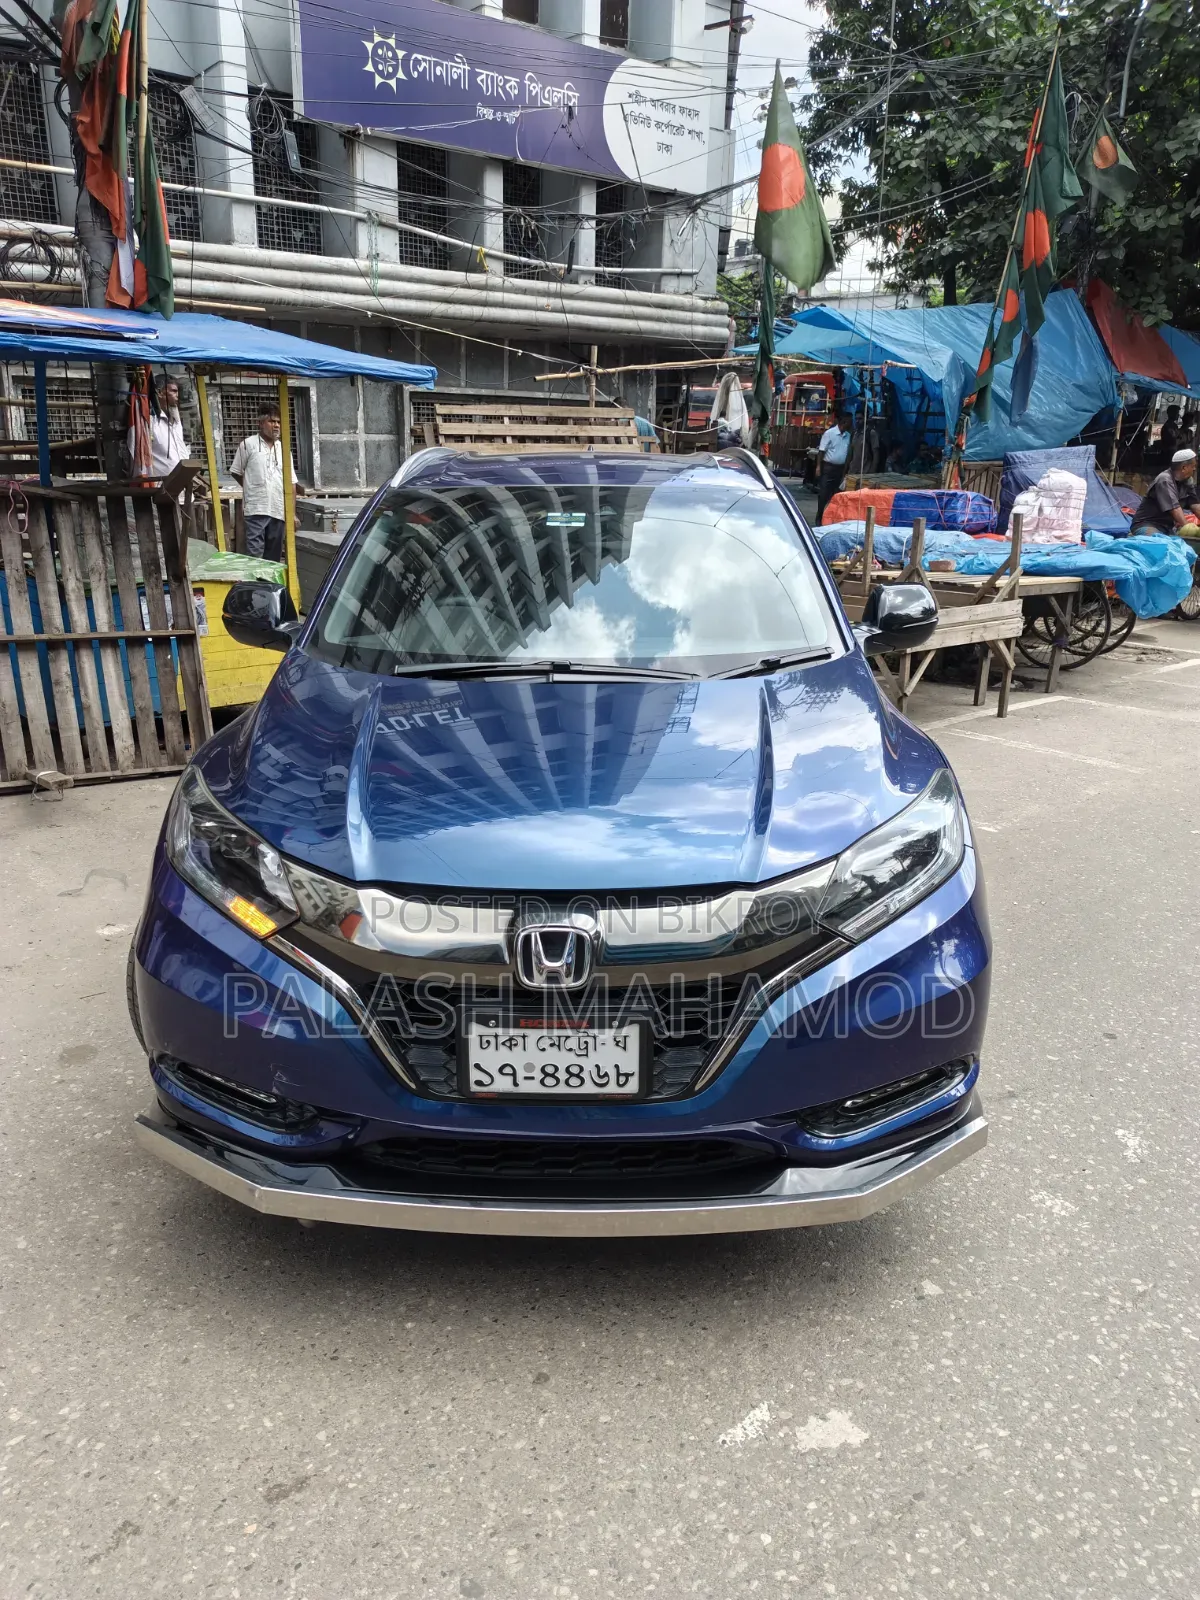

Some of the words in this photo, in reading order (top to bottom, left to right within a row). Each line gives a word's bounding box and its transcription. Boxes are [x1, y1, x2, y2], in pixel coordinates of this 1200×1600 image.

[410, 53, 470, 91] সোনালী
[475, 68, 520, 101] ব্যাংক
[524, 72, 580, 115] পিএলসি
[678, 105, 700, 121] ফাহাদ
[656, 141, 673, 156] ঢাকা
[478, 1032, 528, 1052] ঢাকা
[473, 1062, 636, 1088] ১৭-৪৪৬৮
